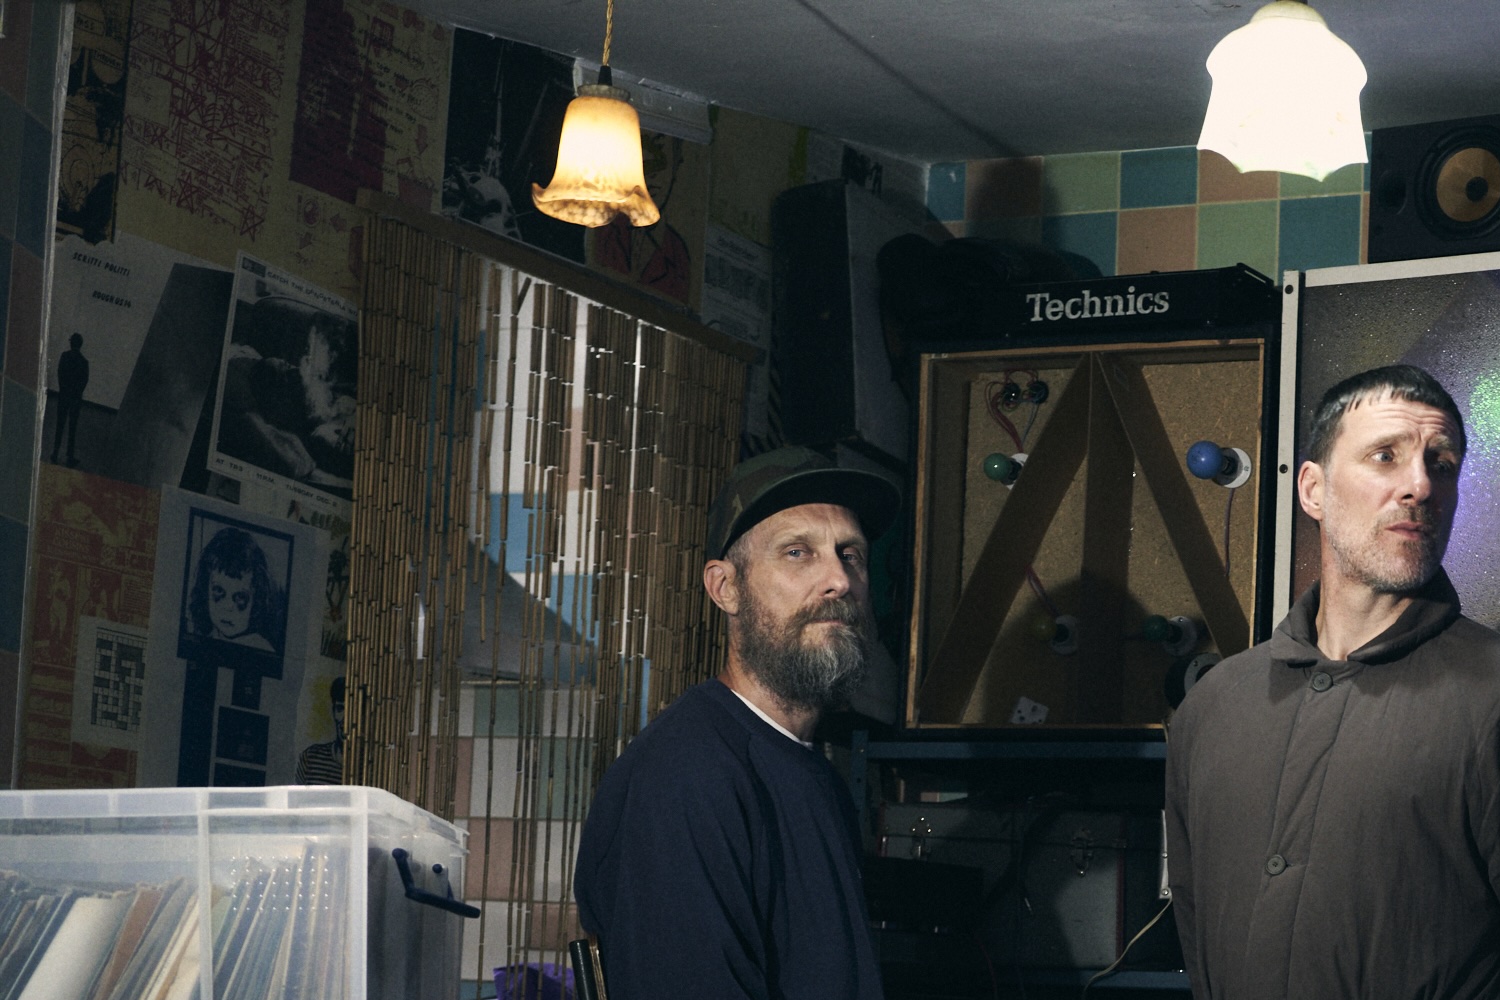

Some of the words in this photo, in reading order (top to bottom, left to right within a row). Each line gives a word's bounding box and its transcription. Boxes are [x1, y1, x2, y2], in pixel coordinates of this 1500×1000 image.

[73, 252, 101, 267] SCRITTI
[104, 262, 130, 276] POLITTI
[1026, 285, 1169, 322] Technics
